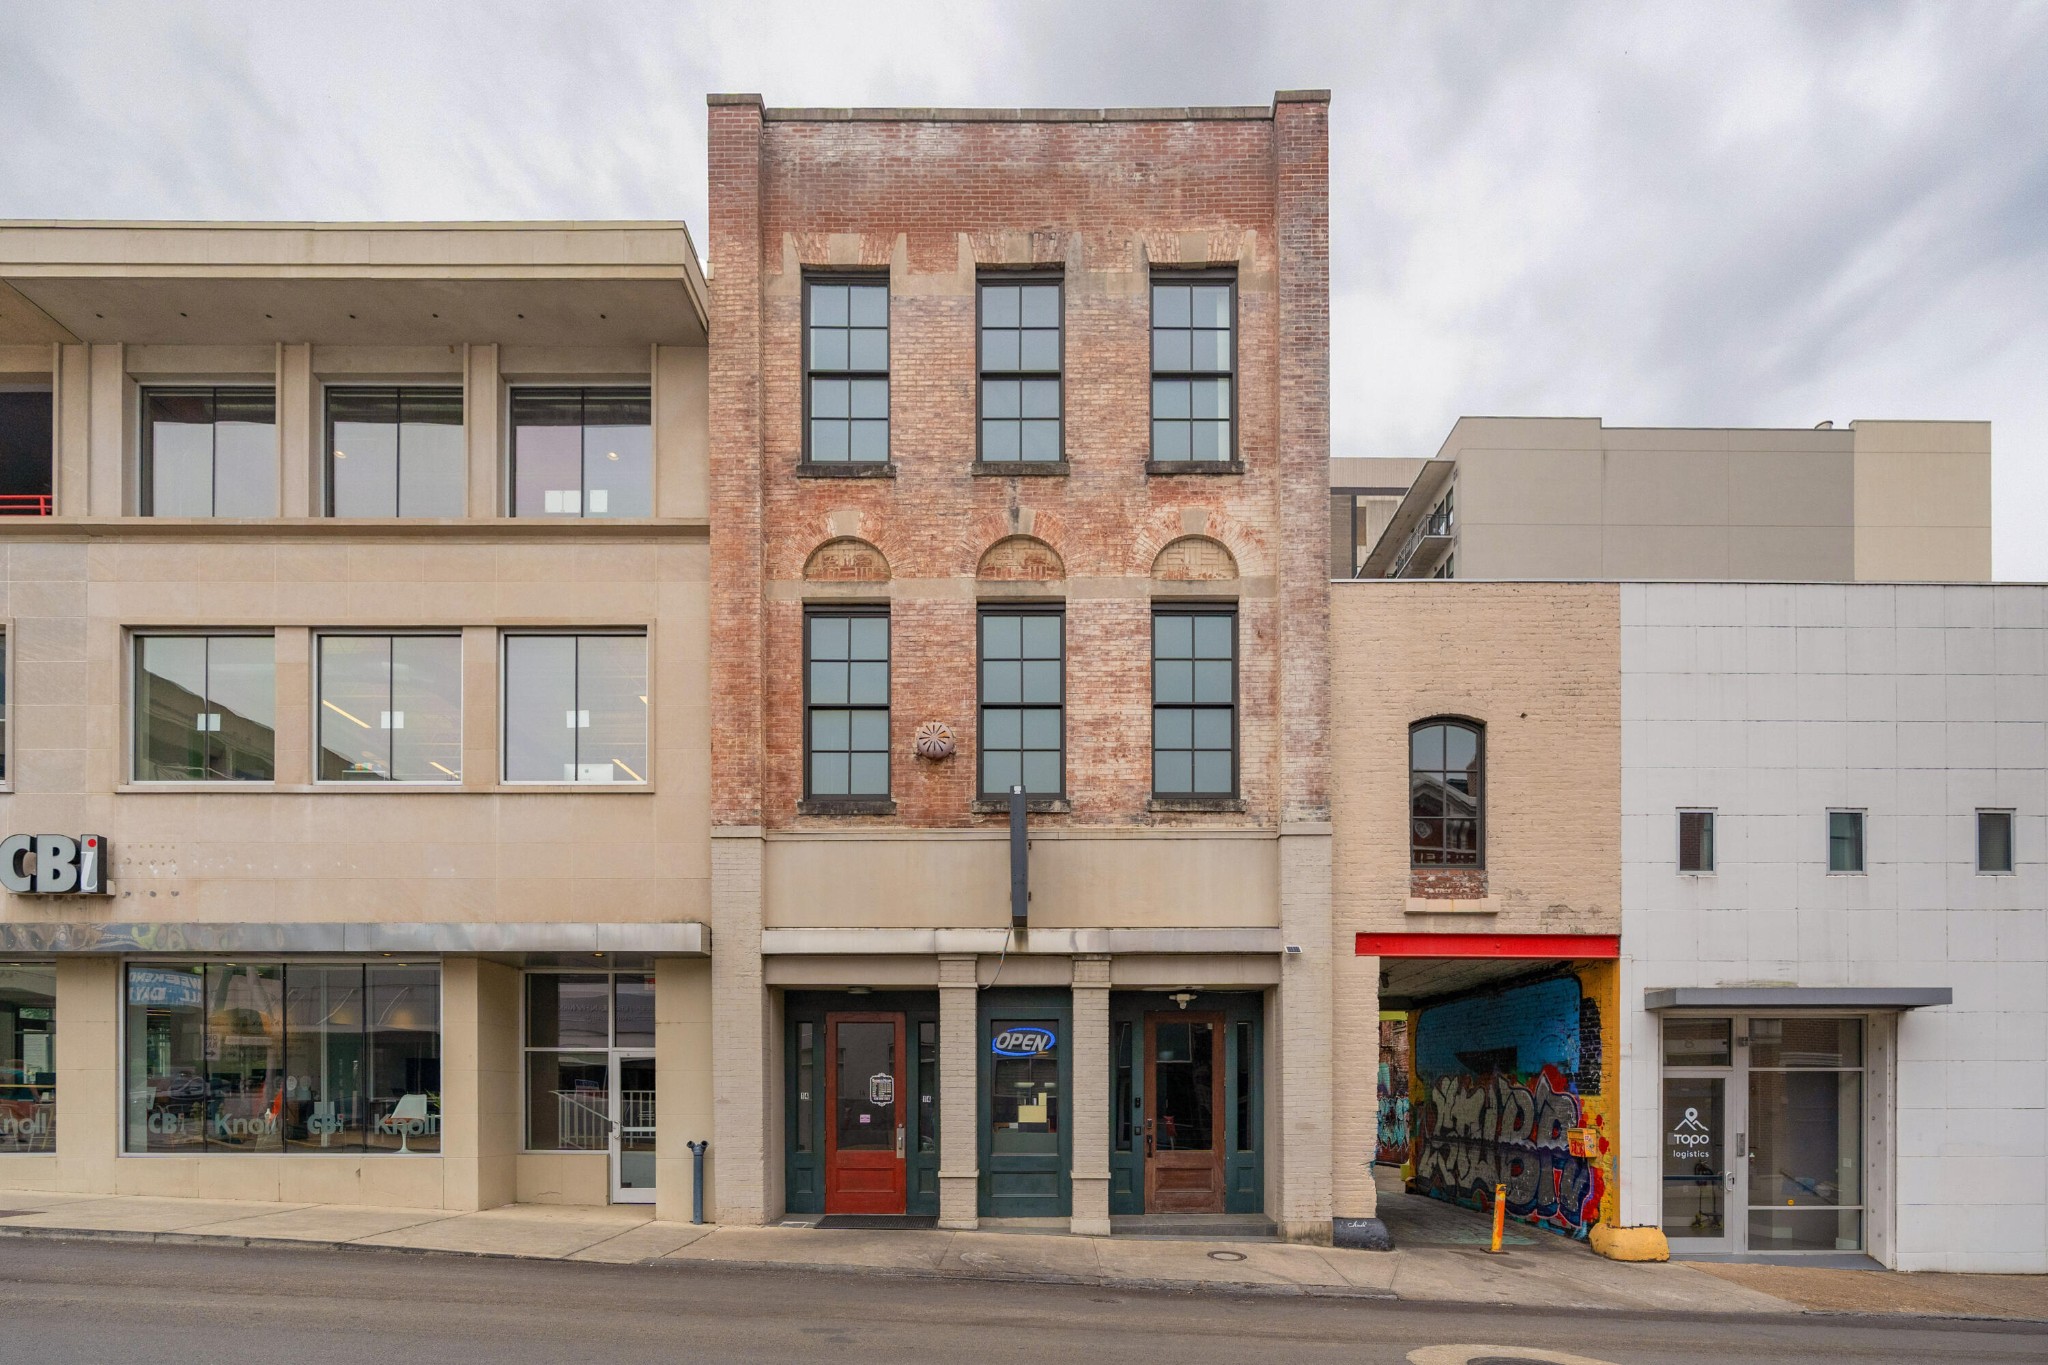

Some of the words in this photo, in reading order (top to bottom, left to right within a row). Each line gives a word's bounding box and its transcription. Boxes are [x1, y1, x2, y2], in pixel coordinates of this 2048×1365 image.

[0, 834, 106, 893] CBi
[995, 1032, 1048, 1051] OPEN
[148, 1112, 187, 1135] CBi
[214, 1112, 278, 1135] Knoll
[307, 1113, 344, 1135] CBi
[374, 1113, 436, 1135] Knoll
[1673, 1150, 1709, 1158] logistics
